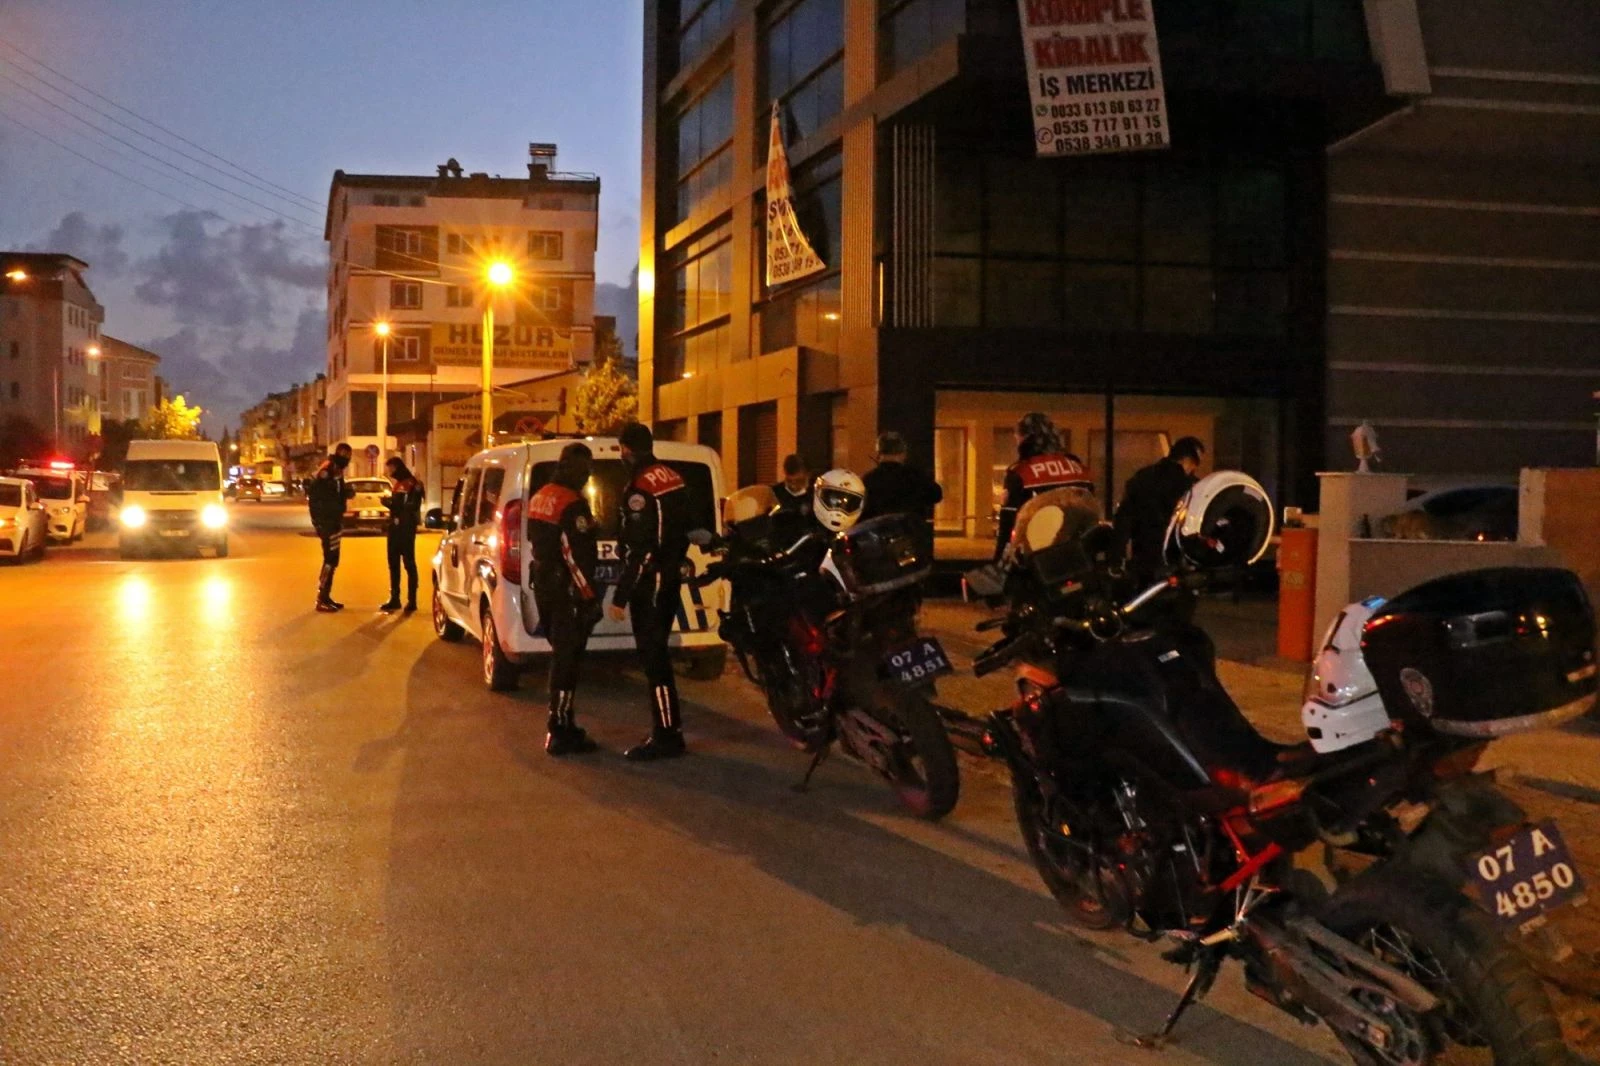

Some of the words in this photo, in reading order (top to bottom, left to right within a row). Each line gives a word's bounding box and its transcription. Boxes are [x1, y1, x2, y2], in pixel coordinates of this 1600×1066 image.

[1040, 74, 1060, 98] İŞ
[1065, 67, 1155, 95] MERKEZİ
[1053, 119, 1088, 136] 0535
[1092, 118, 1117, 132] 717
[1144, 115, 1161, 129] 15
[891, 651, 913, 667] 07
[923, 642, 936, 656] A
[901, 657, 945, 682] 4851
[1478, 845, 1515, 881] 07
[1531, 829, 1556, 857] A
[1496, 862, 1574, 918] 4850
